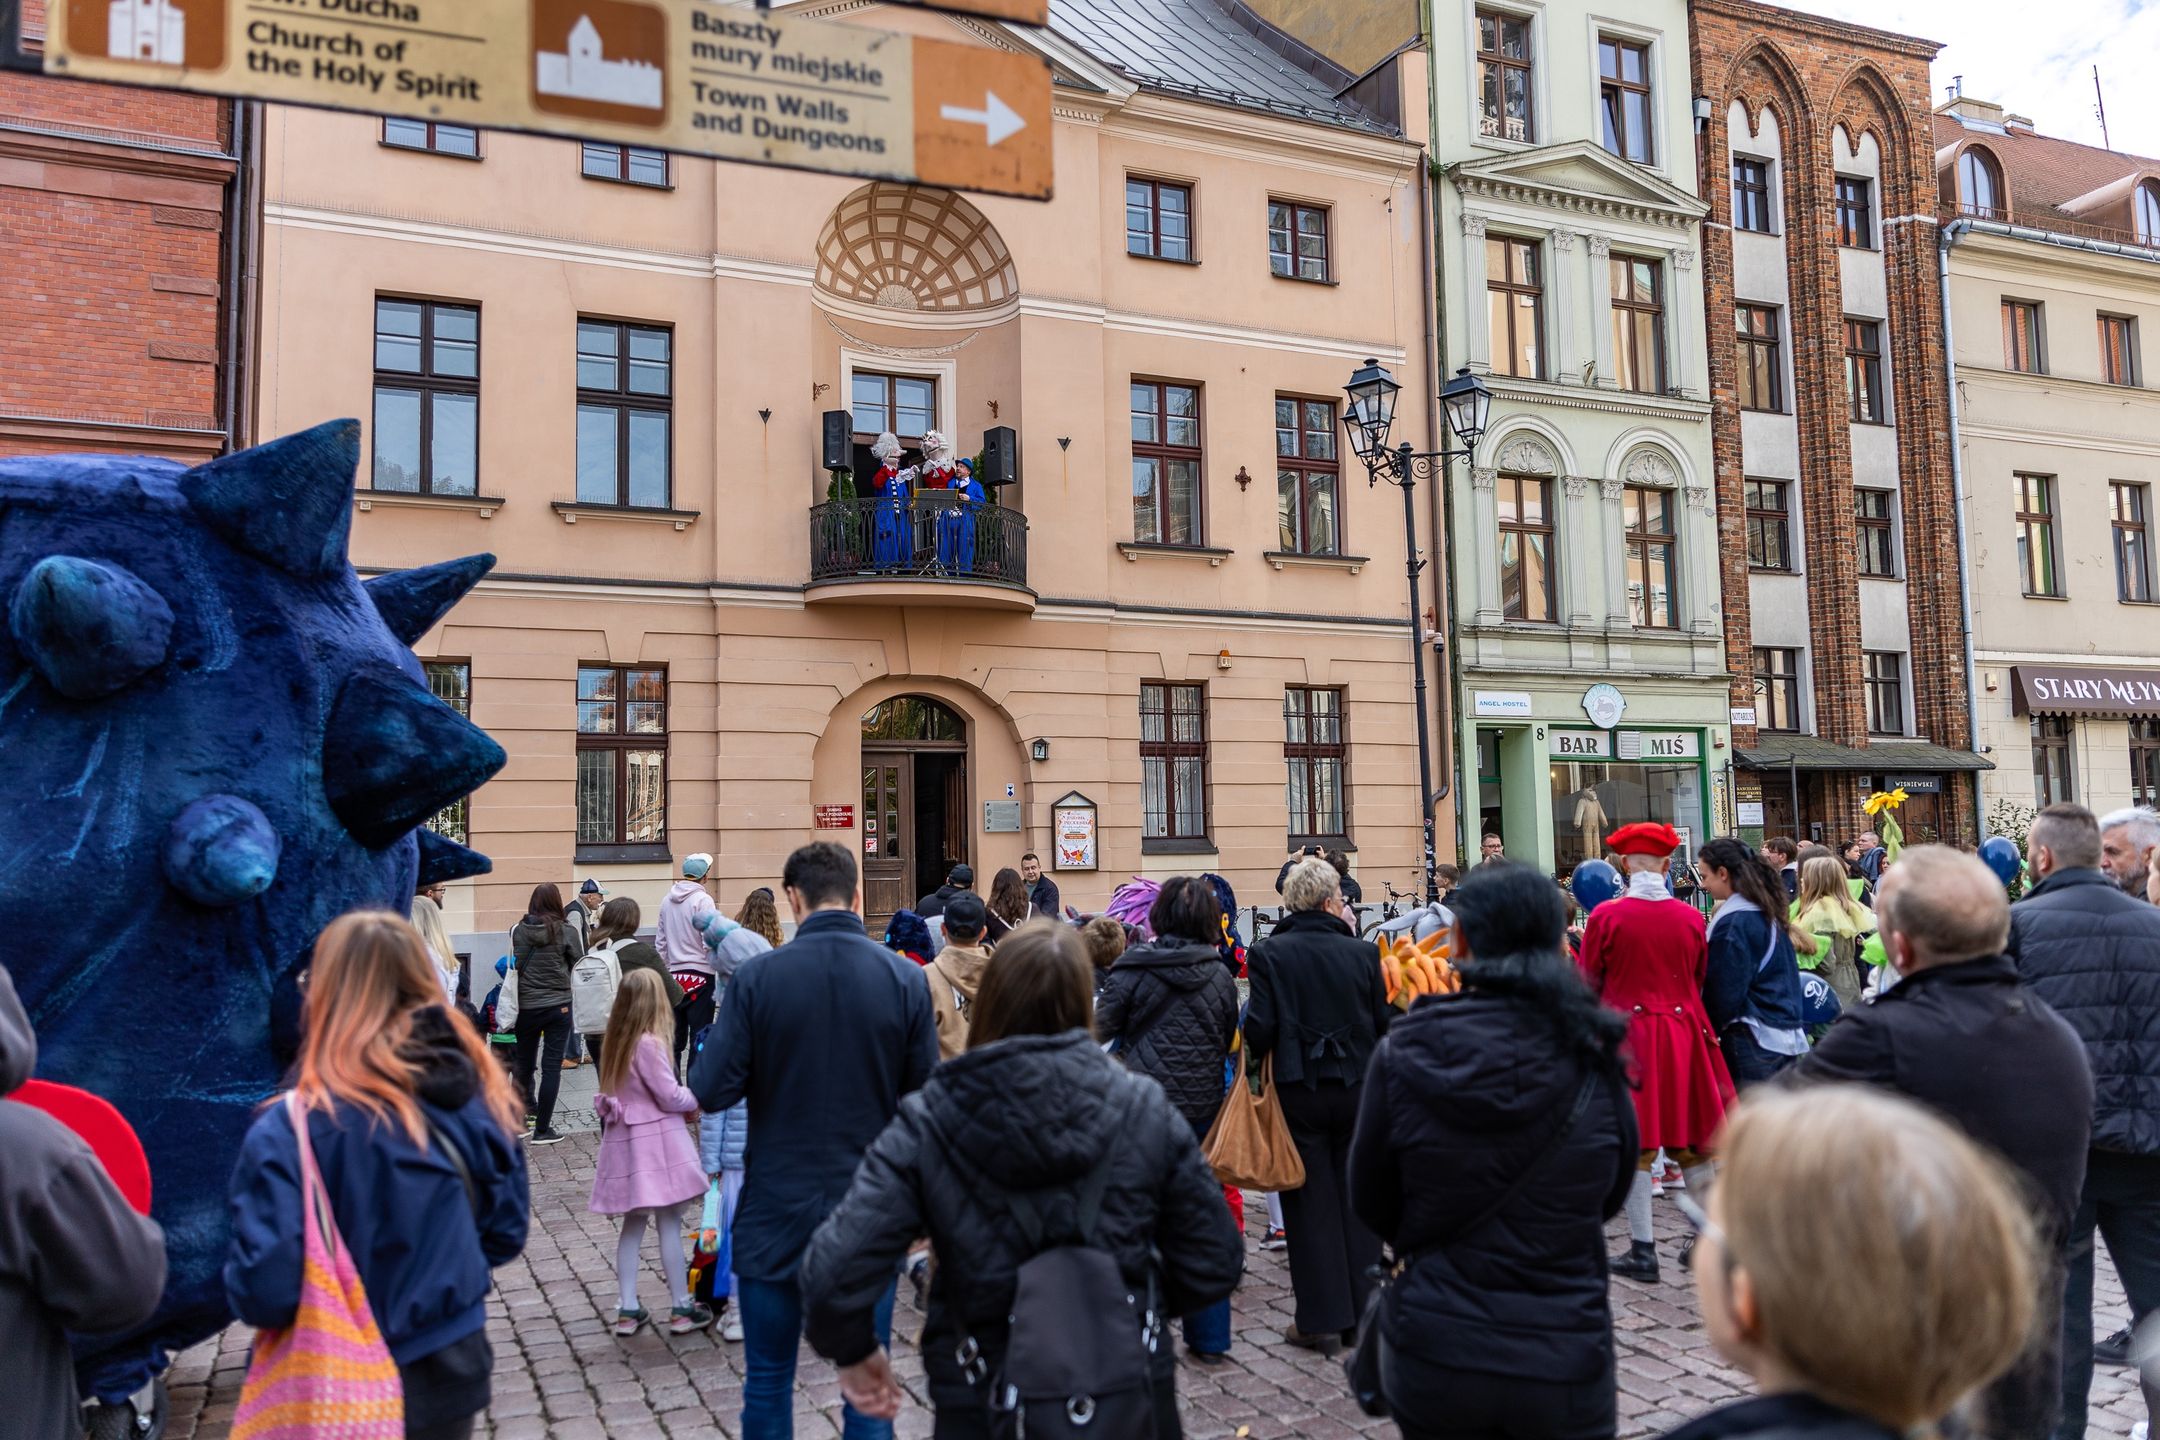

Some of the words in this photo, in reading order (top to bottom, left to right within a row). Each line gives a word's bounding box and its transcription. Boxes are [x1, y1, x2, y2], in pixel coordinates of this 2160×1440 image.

[248, 21, 363, 56] Church
[374, 41, 407, 61] of
[692, 11, 782, 47] Baszty
[248, 51, 302, 76] the
[313, 60, 385, 92] Holy
[396, 70, 481, 100] Spirit
[692, 42, 762, 70] mury
[772, 54, 883, 86] miejskie
[691, 80, 767, 111] Town
[776, 93, 849, 123] Walls
[692, 112, 743, 134] and
[753, 117, 886, 153] Dungeons
[2034, 678, 2102, 700] STARY
[1536, 728, 1545, 741] 8
[1559, 736, 1598, 753] BAR
[1651, 735, 1684, 754] MIŚ
[1862, 777, 1868, 785] 9
